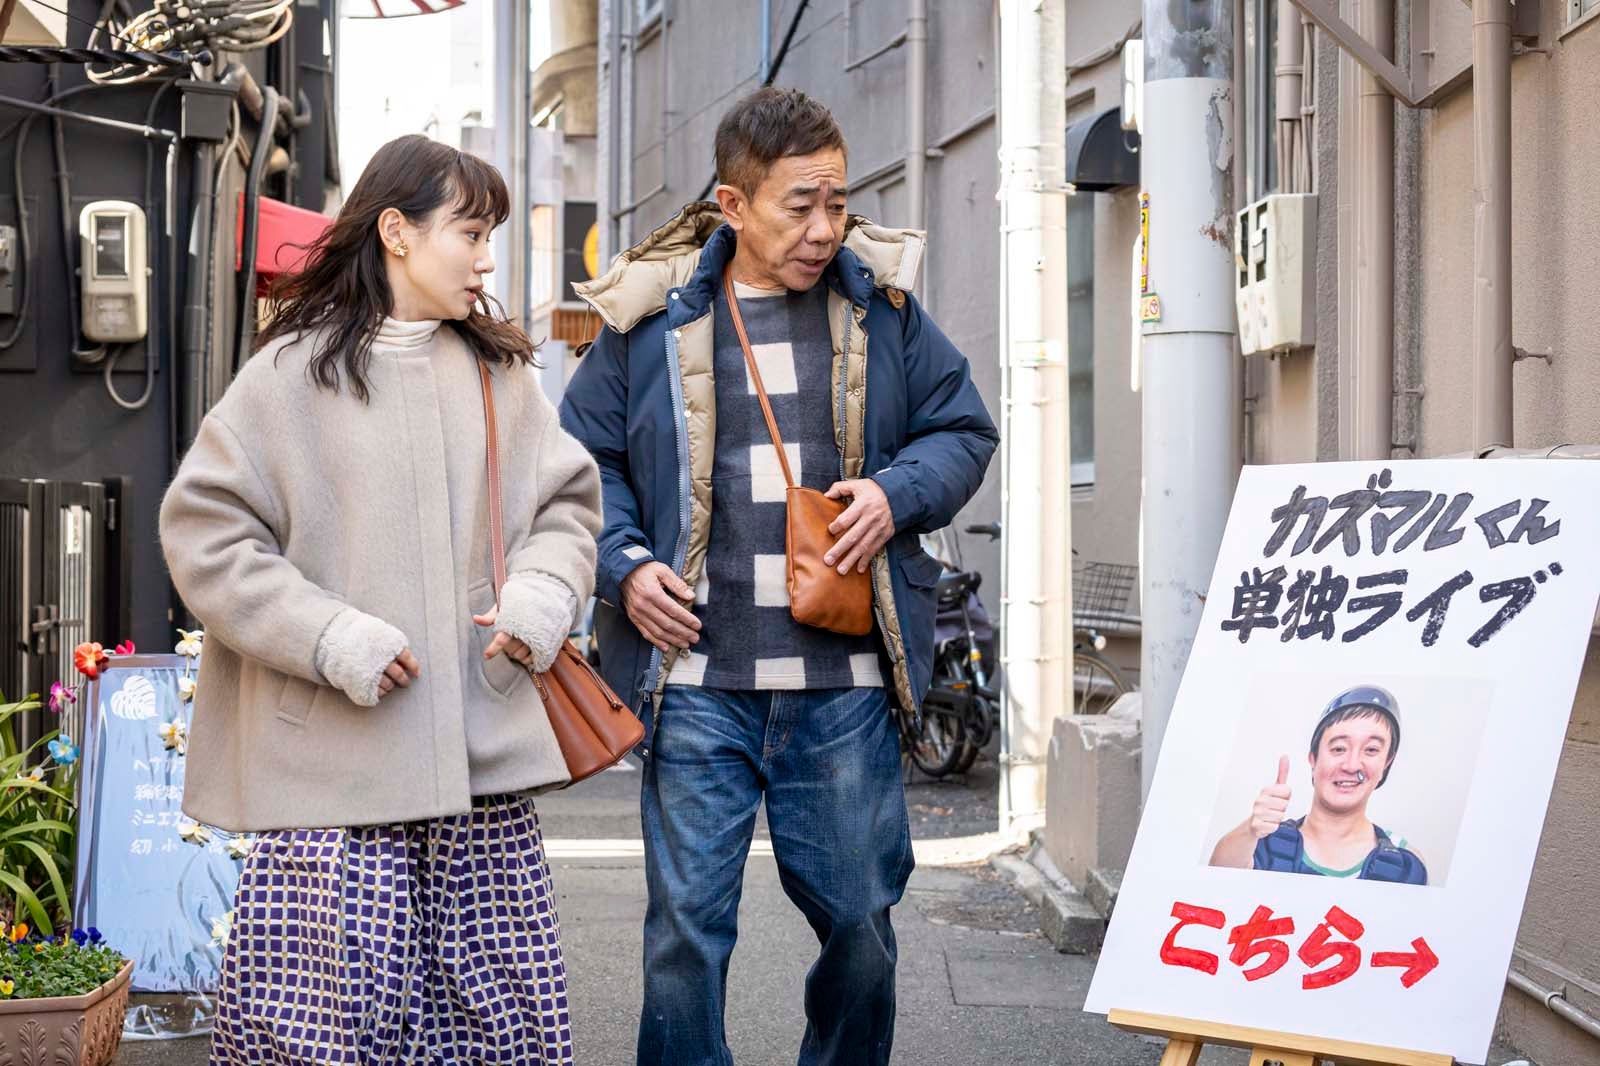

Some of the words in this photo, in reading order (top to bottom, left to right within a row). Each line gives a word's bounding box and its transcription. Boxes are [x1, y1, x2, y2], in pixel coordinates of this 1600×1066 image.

[1263, 468, 1561, 558] カズマルくん
[1220, 562, 1564, 649] 単独ライブ
[1160, 901, 1365, 990] こちら
